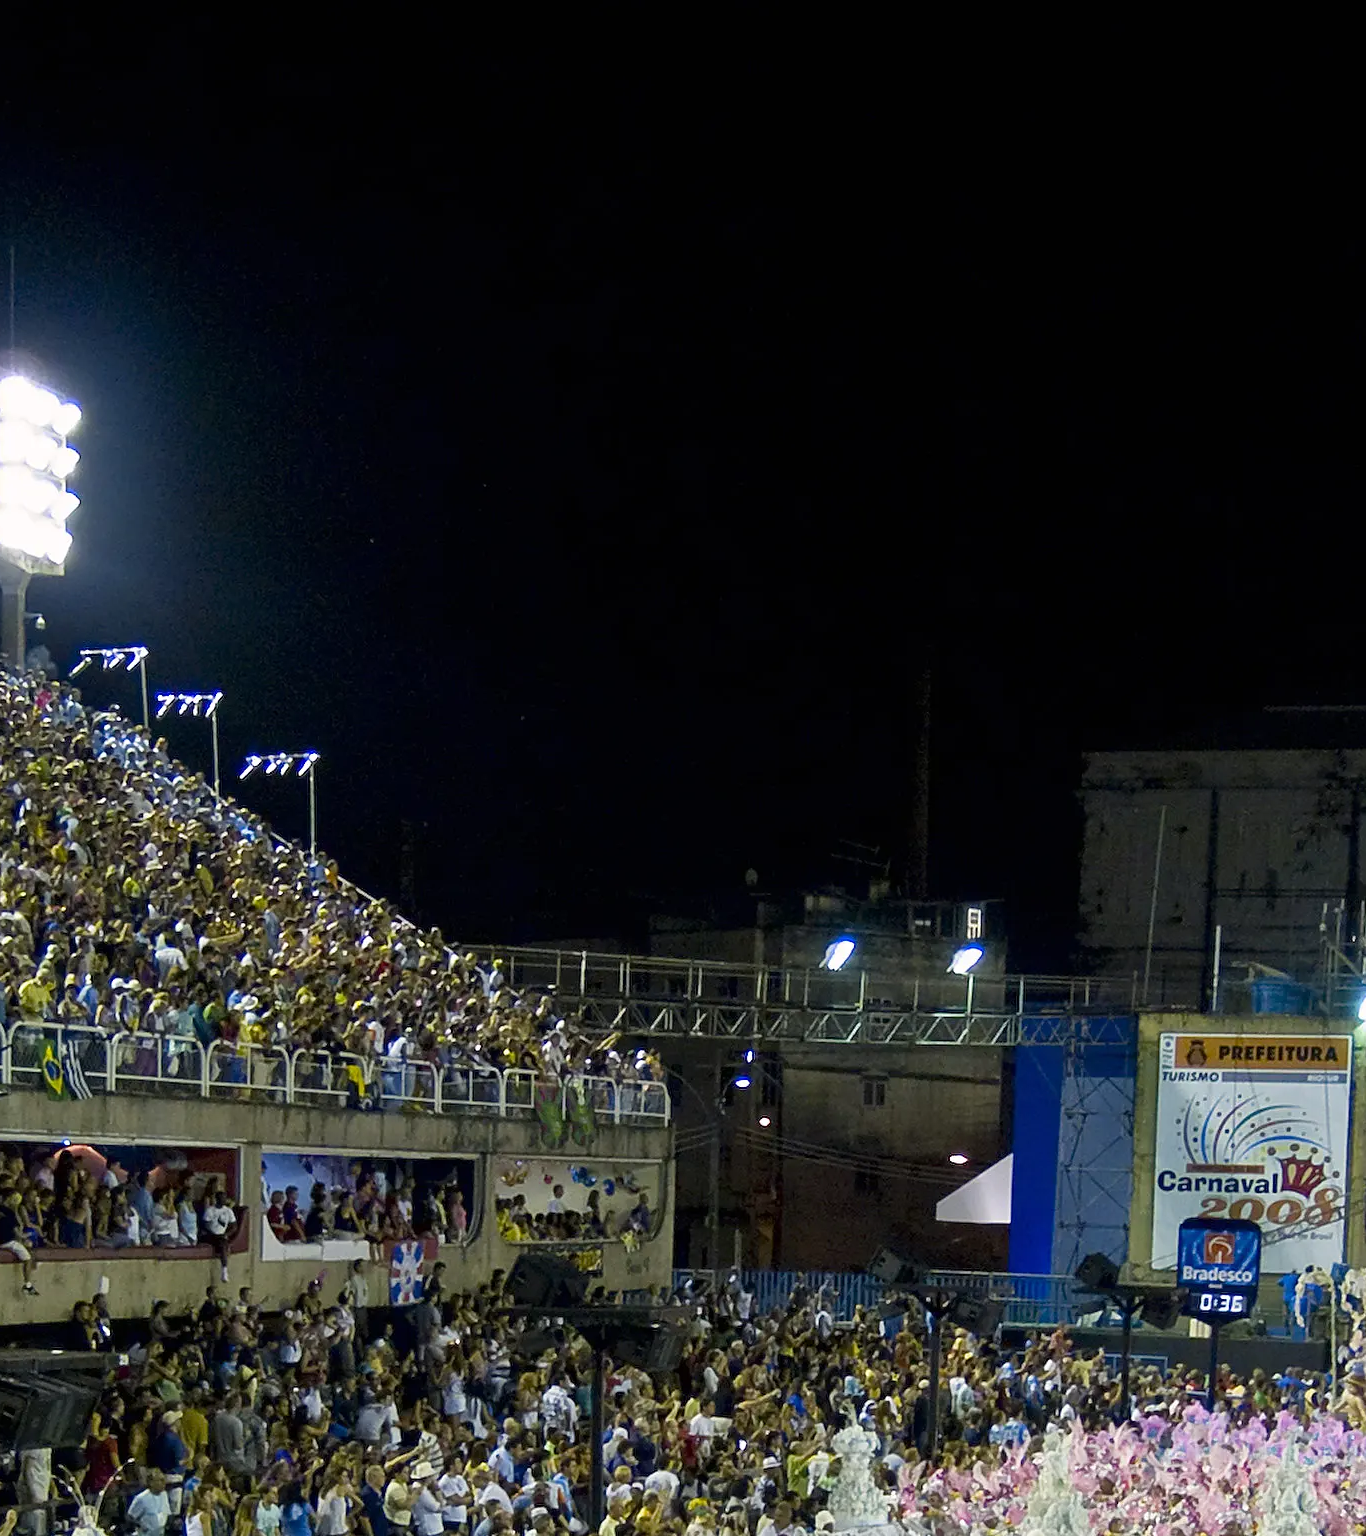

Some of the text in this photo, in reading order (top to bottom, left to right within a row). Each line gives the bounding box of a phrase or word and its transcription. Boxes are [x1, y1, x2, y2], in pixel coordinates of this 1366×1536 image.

[1218, 1045, 1339, 1062] PREFEITURA
[1162, 1071, 1220, 1082] TURISMO
[1157, 1170, 1279, 1194] Carnaval
[1197, 1187, 1340, 1227] 2008
[1182, 1265, 1253, 1283] Bradesco
[1199, 1293, 1244, 1313] 0:36
